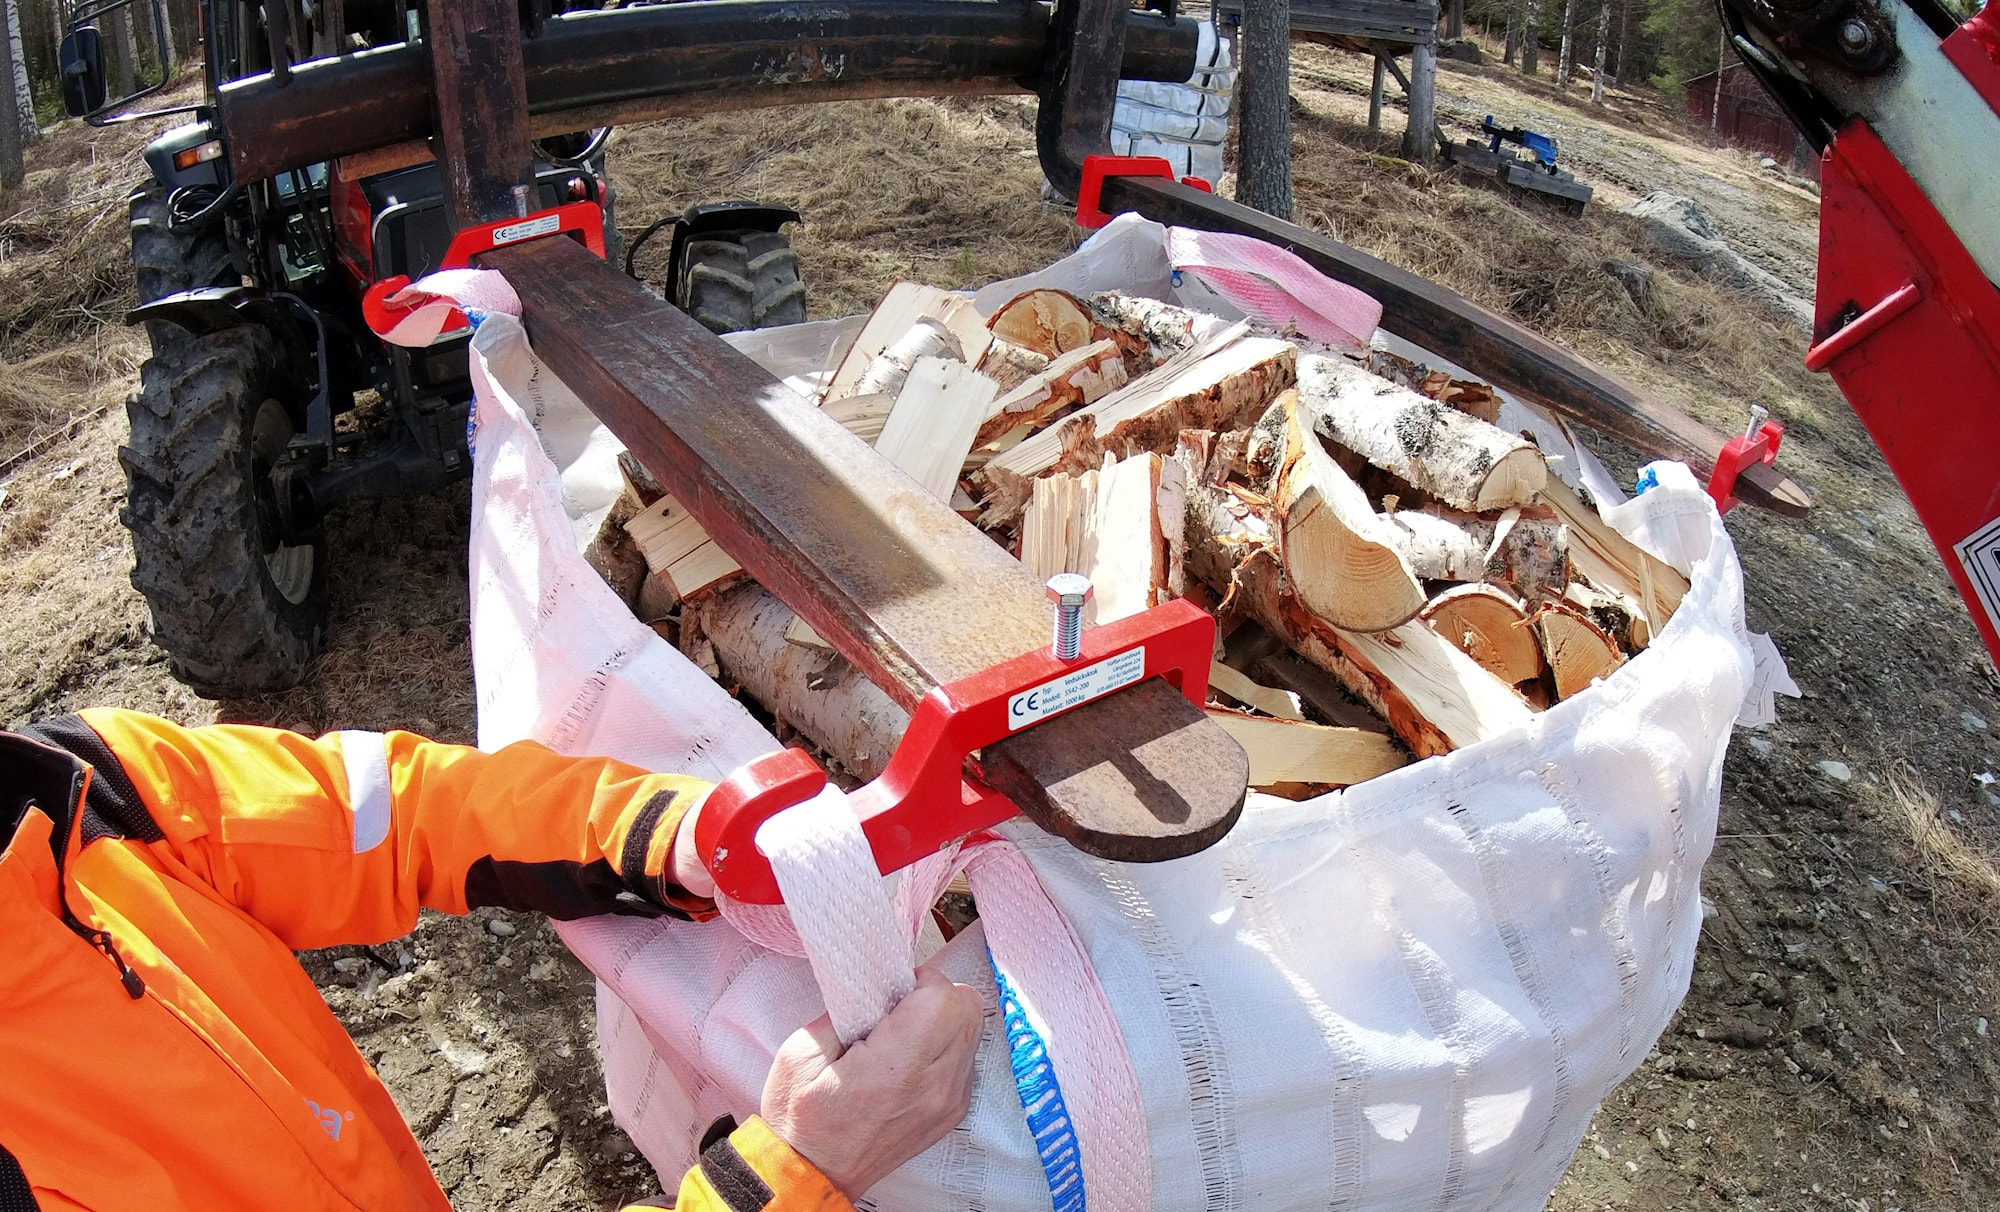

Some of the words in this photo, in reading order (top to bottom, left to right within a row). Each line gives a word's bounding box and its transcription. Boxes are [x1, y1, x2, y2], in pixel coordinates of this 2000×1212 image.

[1042, 686, 1054, 696] Typ:
[1041, 702, 1065, 715] Maxlast:
[1065, 696, 1078, 706] 1000
[1078, 694, 1086, 702] kg
[1042, 693, 1062, 705] Modell:
